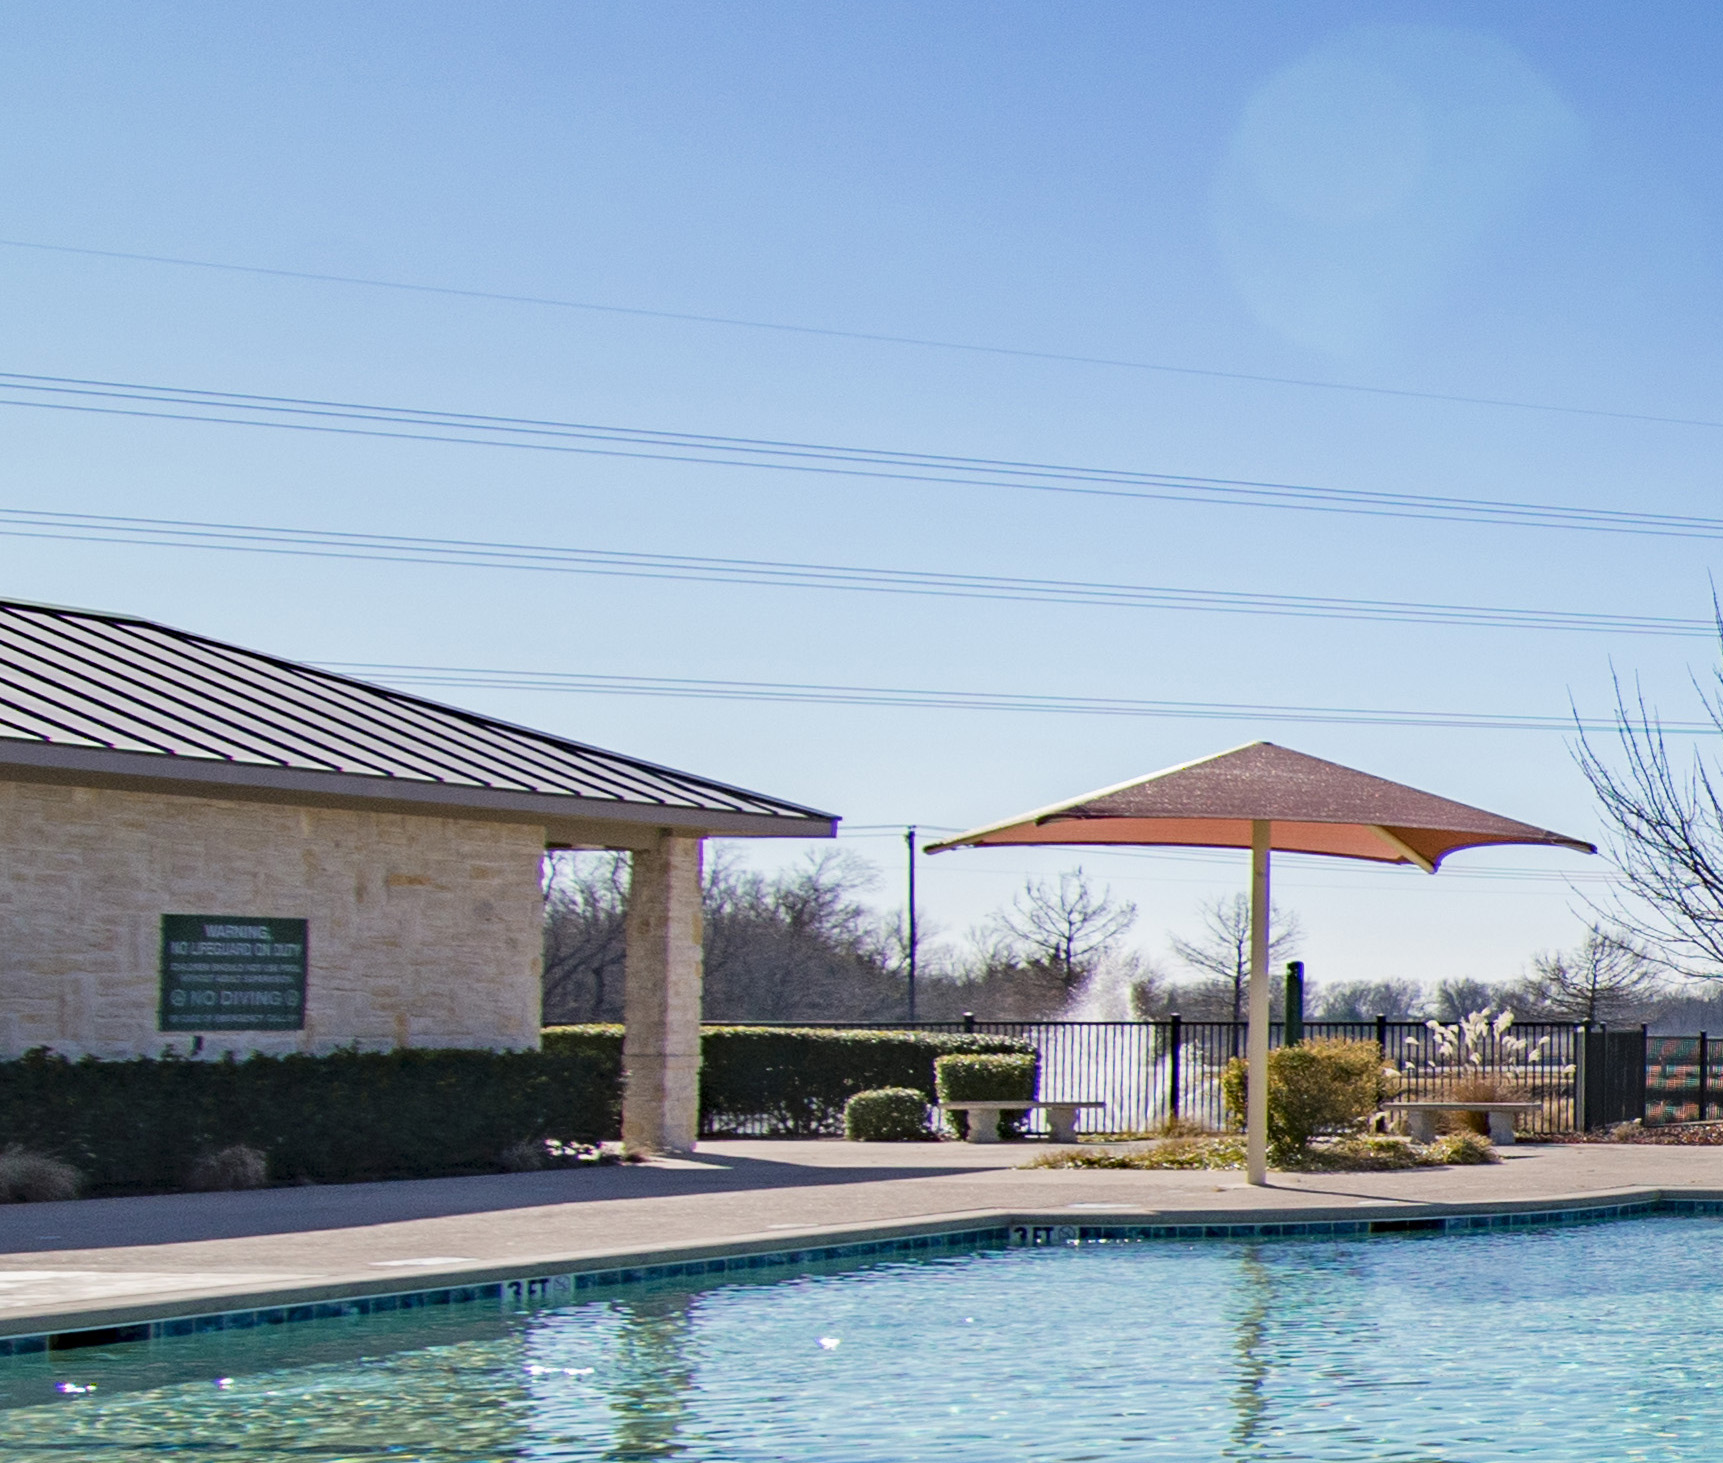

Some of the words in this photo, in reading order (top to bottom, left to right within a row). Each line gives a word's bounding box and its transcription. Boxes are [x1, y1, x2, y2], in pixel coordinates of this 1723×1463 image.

[170, 941, 188, 955] NO
[190, 942, 252, 956] LIFEGUARD
[254, 943, 271, 956] ON
[273, 943, 301, 957] DUTY
[190, 990, 217, 1006] NO
[220, 990, 283, 1006] DIVING
[1032, 1226, 1055, 1243] FT
[527, 1278, 550, 1299] FT
